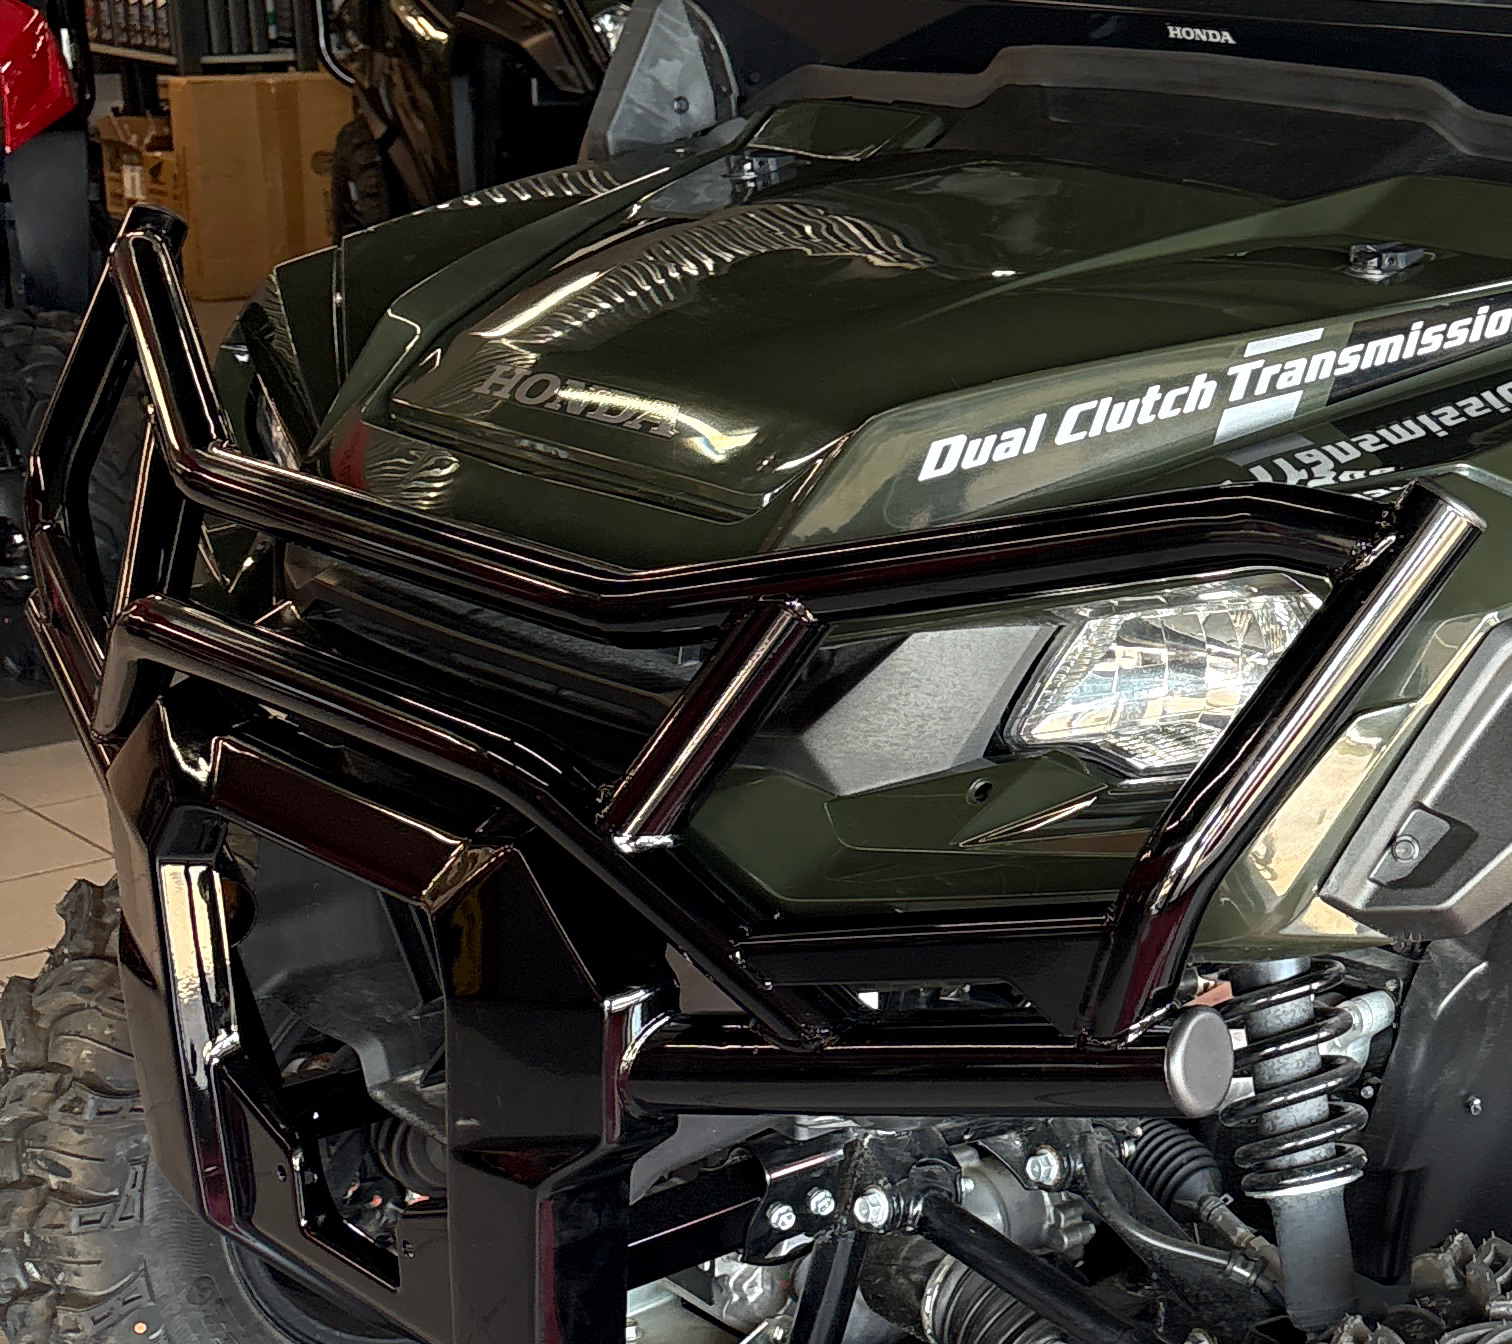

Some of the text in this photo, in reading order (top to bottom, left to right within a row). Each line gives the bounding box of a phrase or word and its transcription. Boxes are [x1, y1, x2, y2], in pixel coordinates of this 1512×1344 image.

[1165, 24, 1237, 45] HONDA
[472, 363, 681, 439] HONDA
[918, 412, 1048, 482] Dual
[1055, 373, 1218, 446] Clutch
